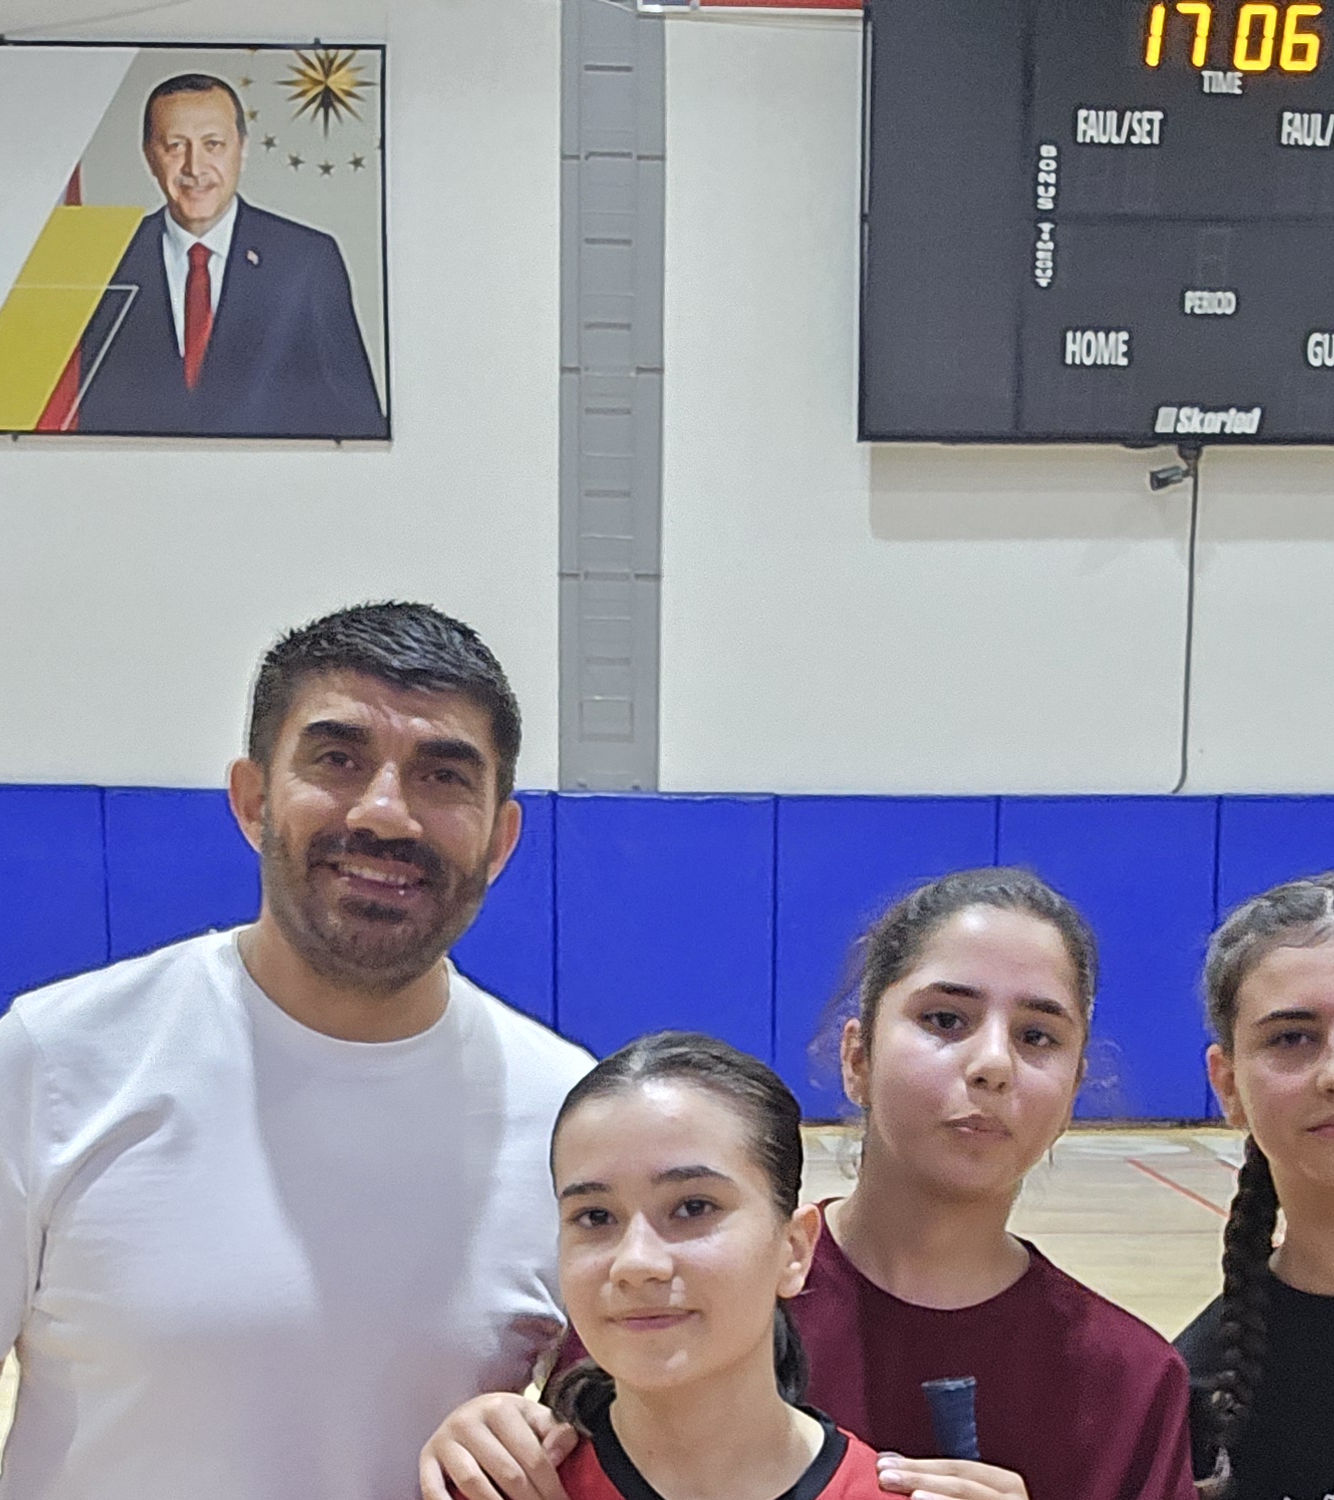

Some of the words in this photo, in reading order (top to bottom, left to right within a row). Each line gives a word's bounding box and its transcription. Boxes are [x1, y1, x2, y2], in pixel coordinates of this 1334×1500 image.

[1200, 70, 1243, 94] TIME
[1076, 108, 1164, 145] FAUL/SET
[1184, 291, 1236, 314] PERIOD
[1065, 330, 1130, 365] HOME
